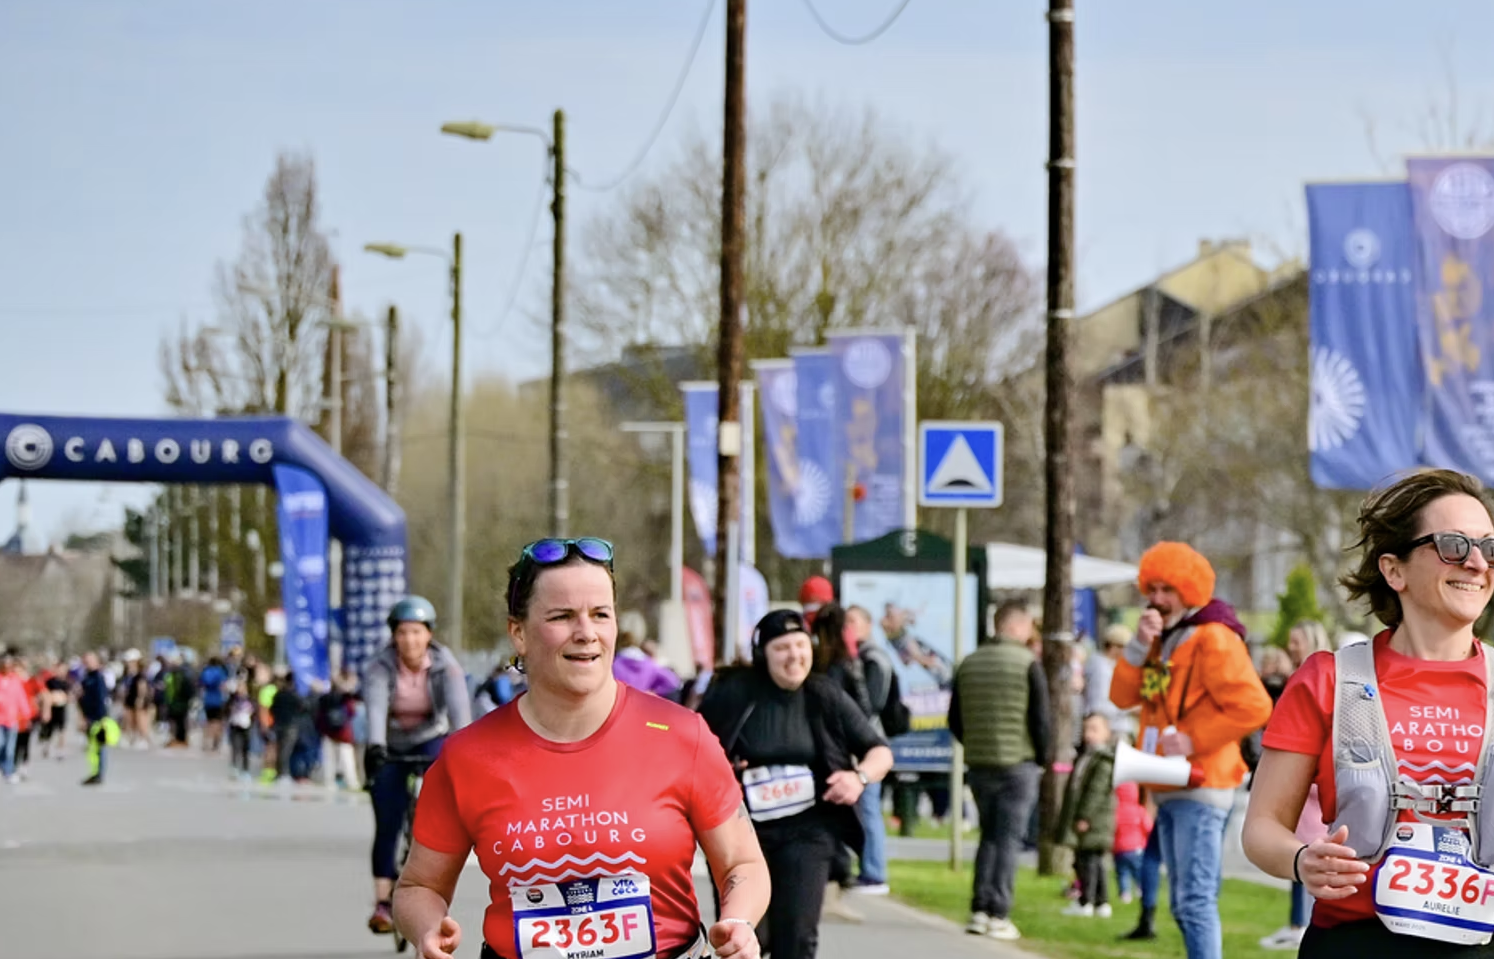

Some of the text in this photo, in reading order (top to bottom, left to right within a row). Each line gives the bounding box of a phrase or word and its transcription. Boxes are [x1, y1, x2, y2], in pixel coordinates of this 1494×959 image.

[64, 436, 273, 464] CABOURG
[1409, 706, 1460, 720] SEMI
[1391, 721, 1483, 737] ARATHO
[541, 794, 590, 812] SEMI
[506, 811, 629, 836] MARATHON
[493, 827, 646, 855] CABOURG
[612, 879, 635, 887] VITA
[611, 887, 639, 896] COCO
[1422, 900, 1462, 915] AURELIE
[531, 911, 639, 949] 2363F
[567, 949, 604, 959] MYRIAM
